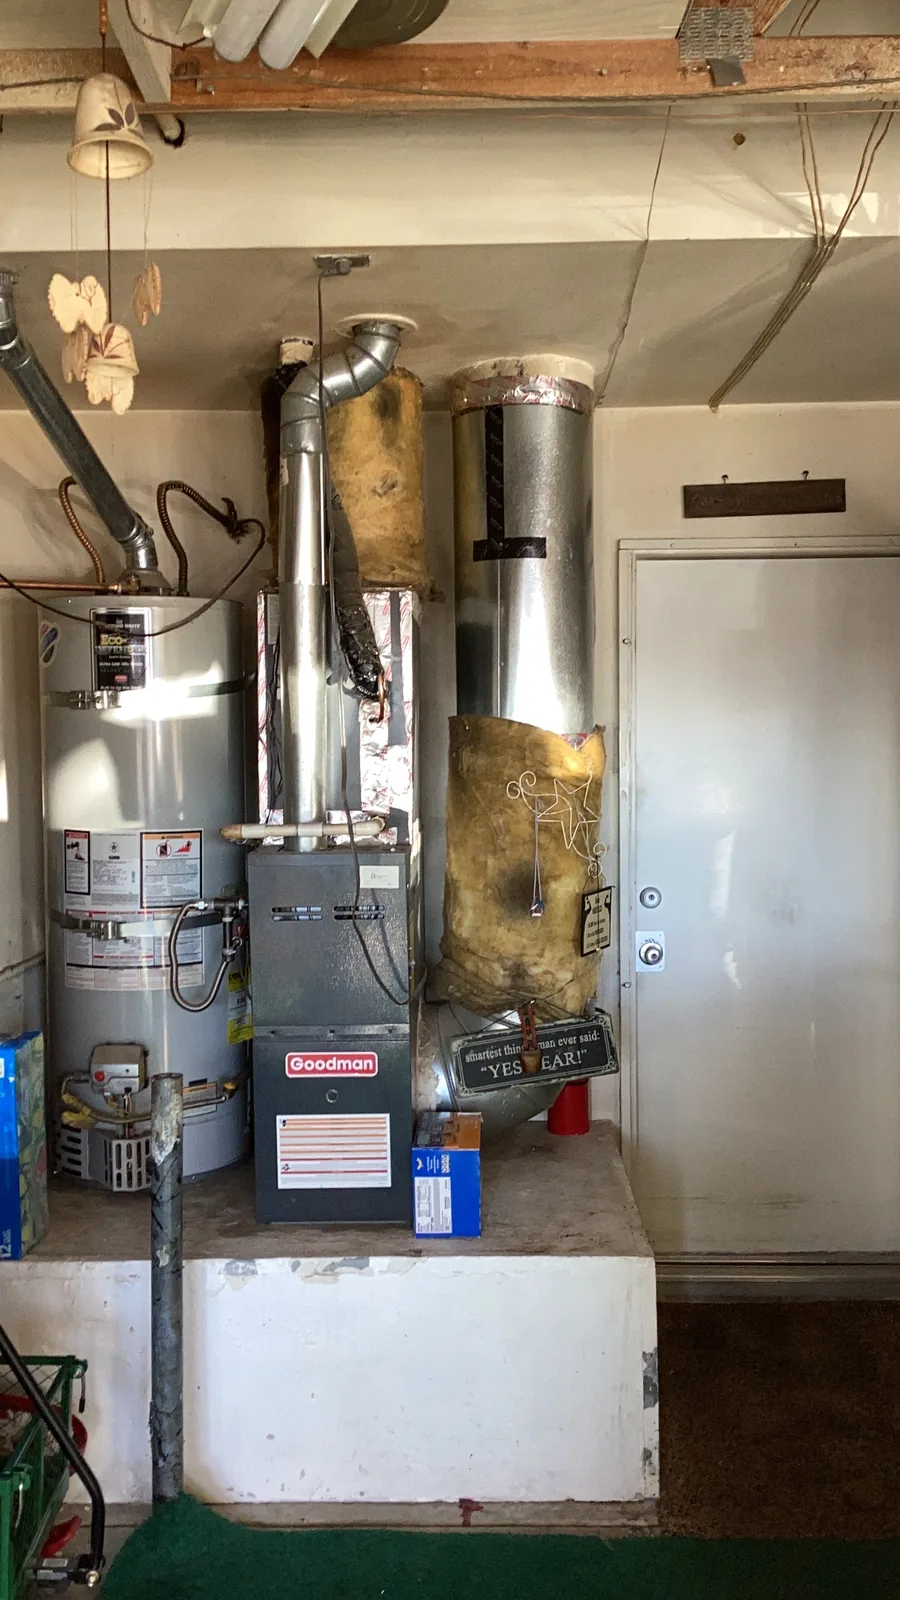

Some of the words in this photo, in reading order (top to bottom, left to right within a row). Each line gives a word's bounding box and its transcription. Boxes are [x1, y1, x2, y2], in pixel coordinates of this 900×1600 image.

[465, 1048, 502, 1063] smartest
[557, 1036, 577, 1047] ever
[579, 1030, 602, 1043] said:
[289, 1057, 373, 1071] Goodman
[480, 1061, 523, 1079] "YES
[541, 1049, 588, 1070] EAR!"
